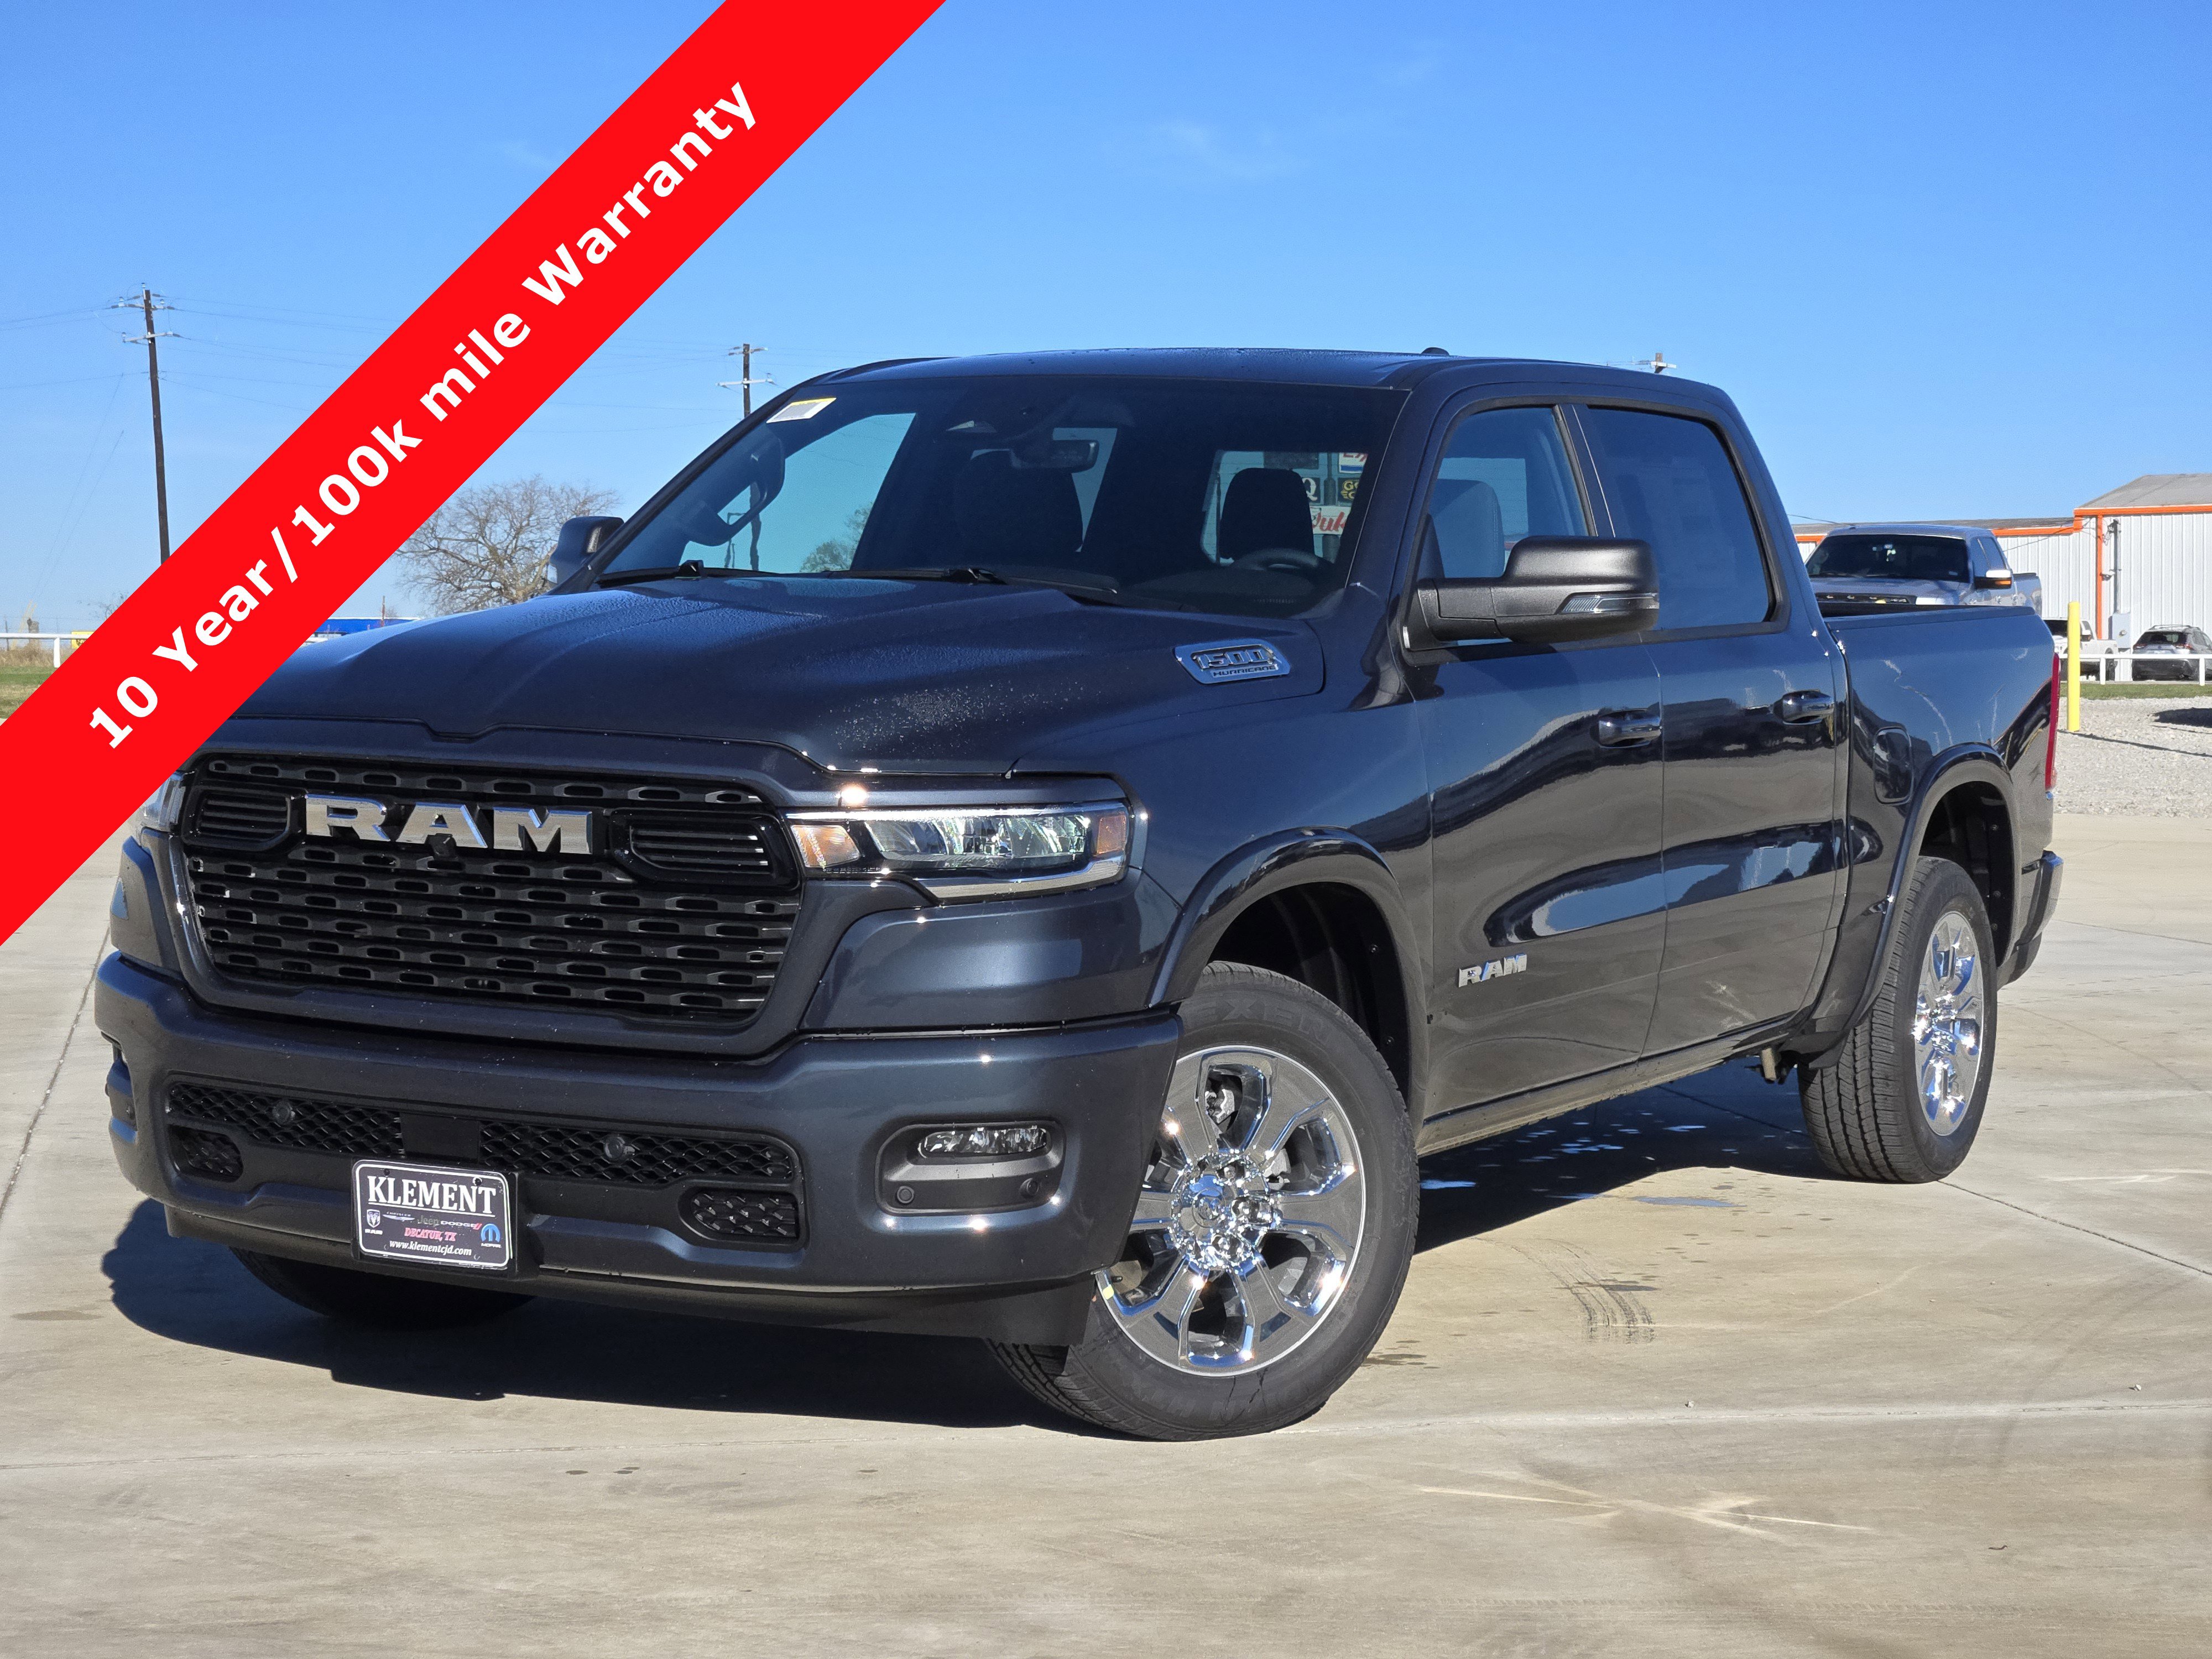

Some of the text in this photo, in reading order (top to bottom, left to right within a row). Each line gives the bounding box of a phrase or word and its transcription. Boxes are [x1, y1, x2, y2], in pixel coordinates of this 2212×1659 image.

[1192, 646, 1276, 670] 1500
[1213, 665, 1276, 677] HURRICANE
[305, 794, 593, 855] RAM
[1458, 953, 1527, 988] RAM
[367, 1175, 497, 1214] KLEMENT
[418, 1215, 440, 1227] Jeep
[404, 1227, 457, 1242] DECATUR, TX
[389, 1239, 472, 1256] www.klementcjd.com
